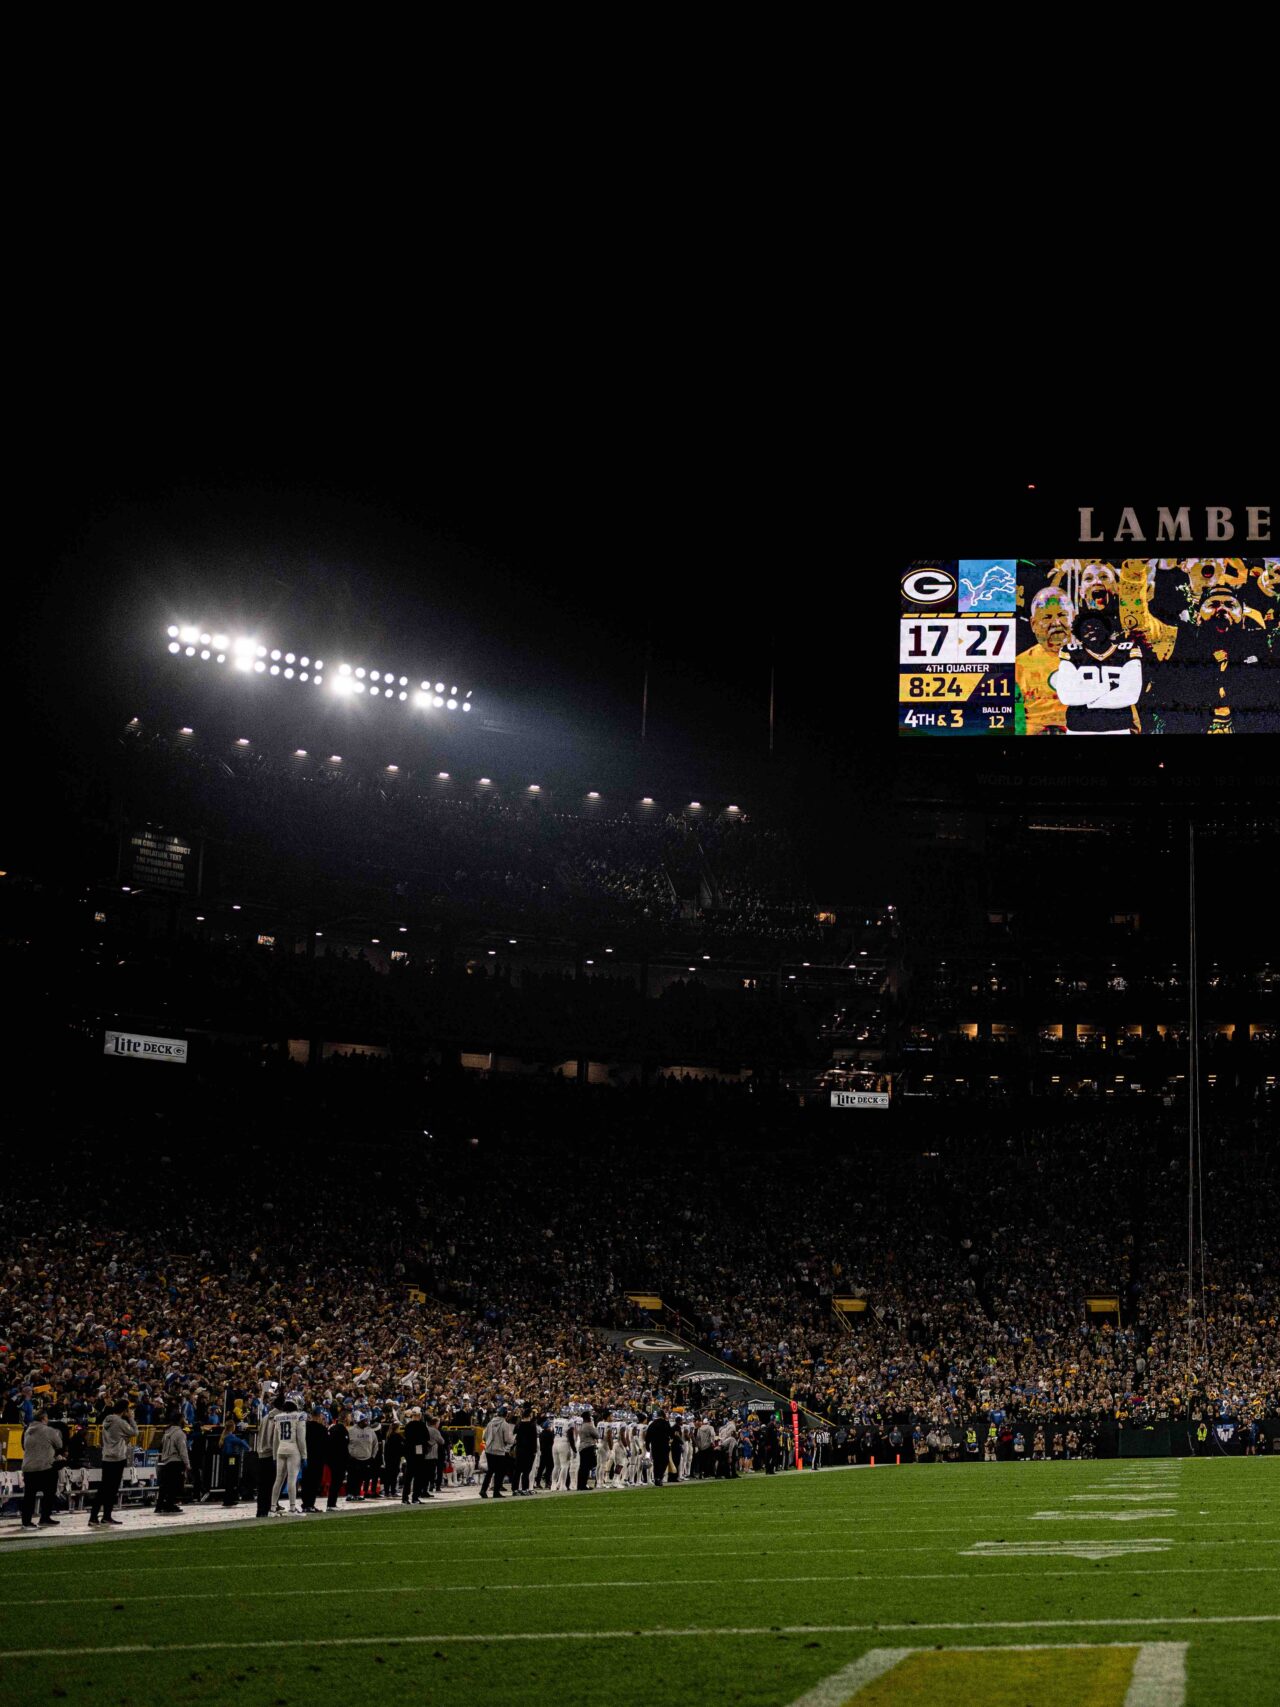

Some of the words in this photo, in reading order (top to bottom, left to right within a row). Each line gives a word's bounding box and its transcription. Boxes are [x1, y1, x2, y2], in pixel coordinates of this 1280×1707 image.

[908, 625, 949, 657] 17
[966, 624, 1010, 657] 27
[925, 664, 944, 673] 4TH
[946, 664, 990, 674] QUARTER
[909, 677, 963, 698] 8:24
[980, 679, 1011, 697] :11
[904, 709, 935, 728] 4TH
[937, 714, 948, 727] &
[950, 709, 964, 728] 3
[982, 706, 1000, 714] BALL
[1001, 706, 1012, 714] ON
[988, 715, 1005, 729] 12
[113, 1036, 141, 1055] Lite
[143, 1042, 173, 1055] DECK
[836, 1094, 856, 1107] Lite
[857, 1096, 879, 1104] DECK
